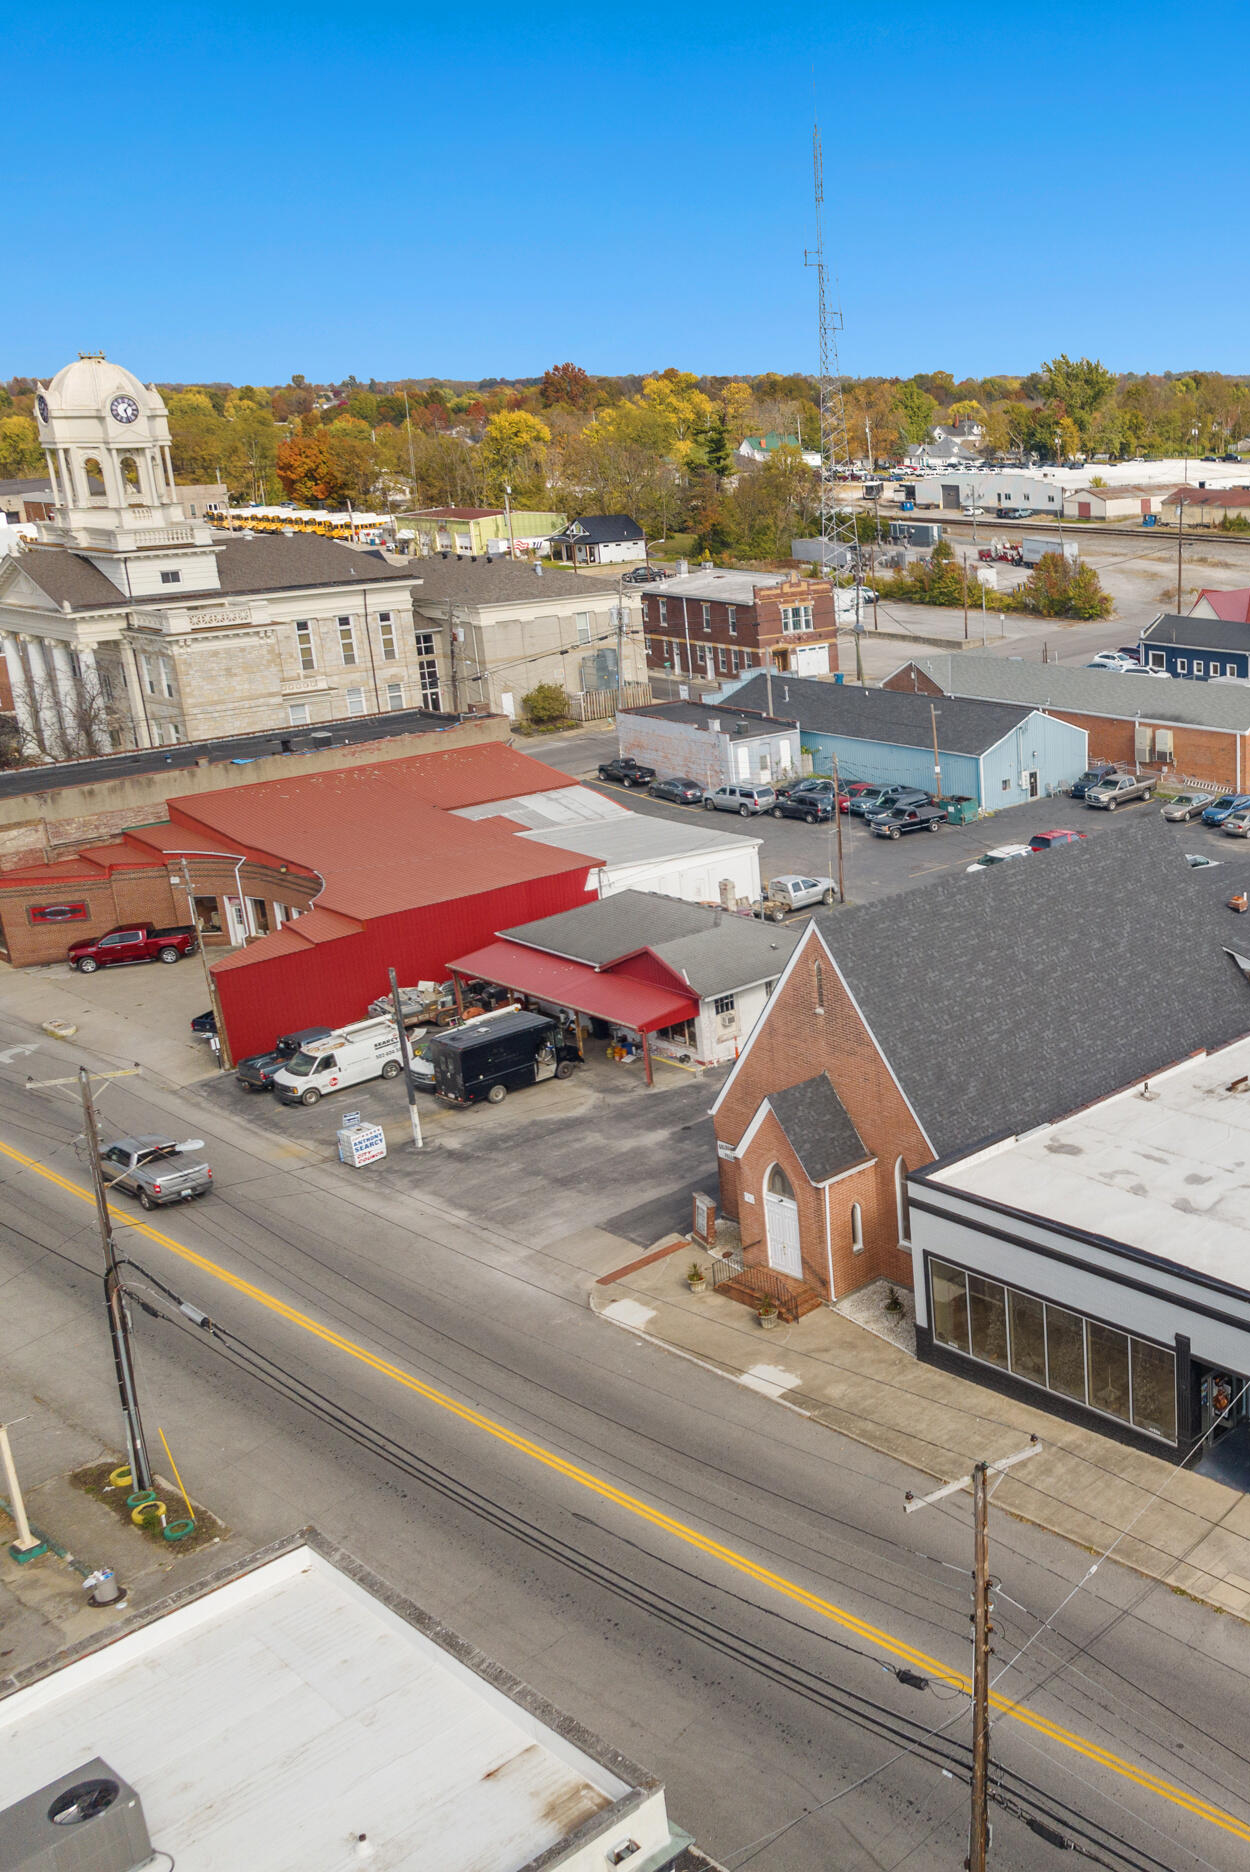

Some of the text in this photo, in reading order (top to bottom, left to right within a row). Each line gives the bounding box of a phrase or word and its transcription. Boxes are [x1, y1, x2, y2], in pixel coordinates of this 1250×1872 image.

[374, 1036, 398, 1047] SEARCY
[354, 1133, 382, 1147] ANTHONY
[355, 1138, 383, 1152] SEARCY
